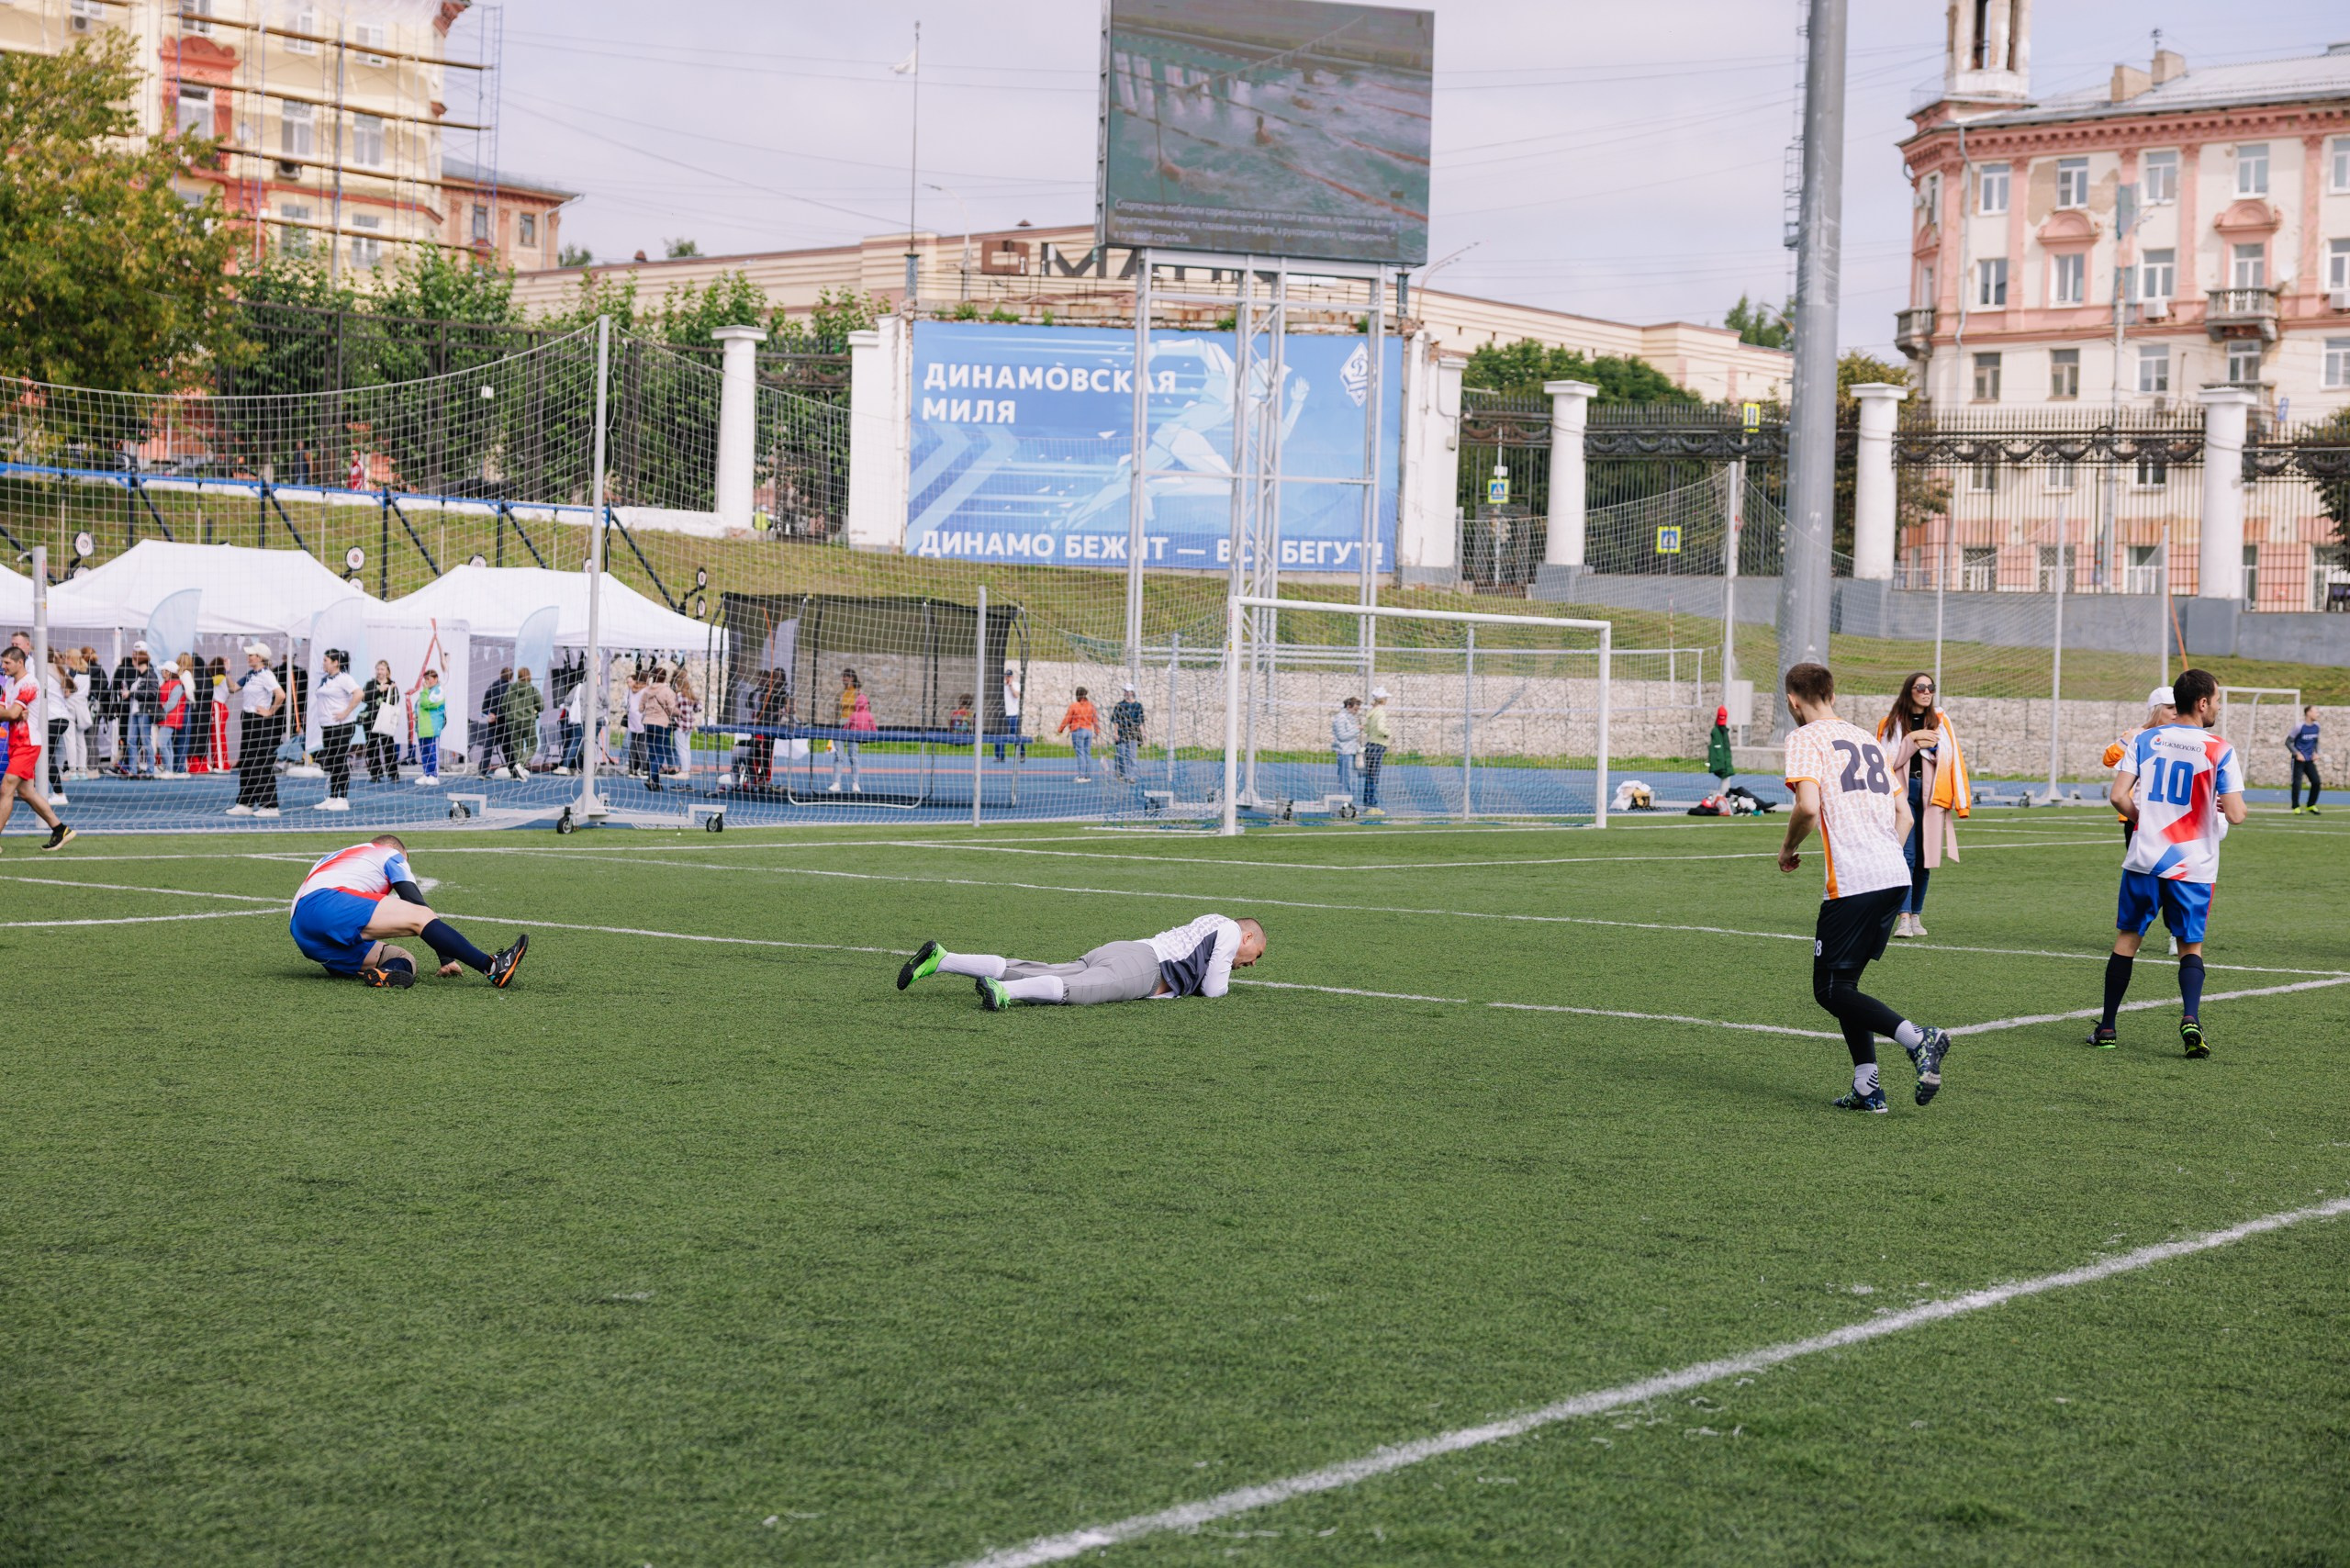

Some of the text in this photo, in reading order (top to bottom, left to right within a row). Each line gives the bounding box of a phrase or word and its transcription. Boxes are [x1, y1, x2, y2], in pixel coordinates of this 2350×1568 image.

[922, 397, 1016, 424] МИЛЯ
[918, 530, 1056, 558] ДИНАМО
[1216, 538, 1265, 563] ВС
[1831, 739, 1891, 795] 28
[2148, 756, 2194, 806] 10
[1813, 939, 1823, 957] 8
